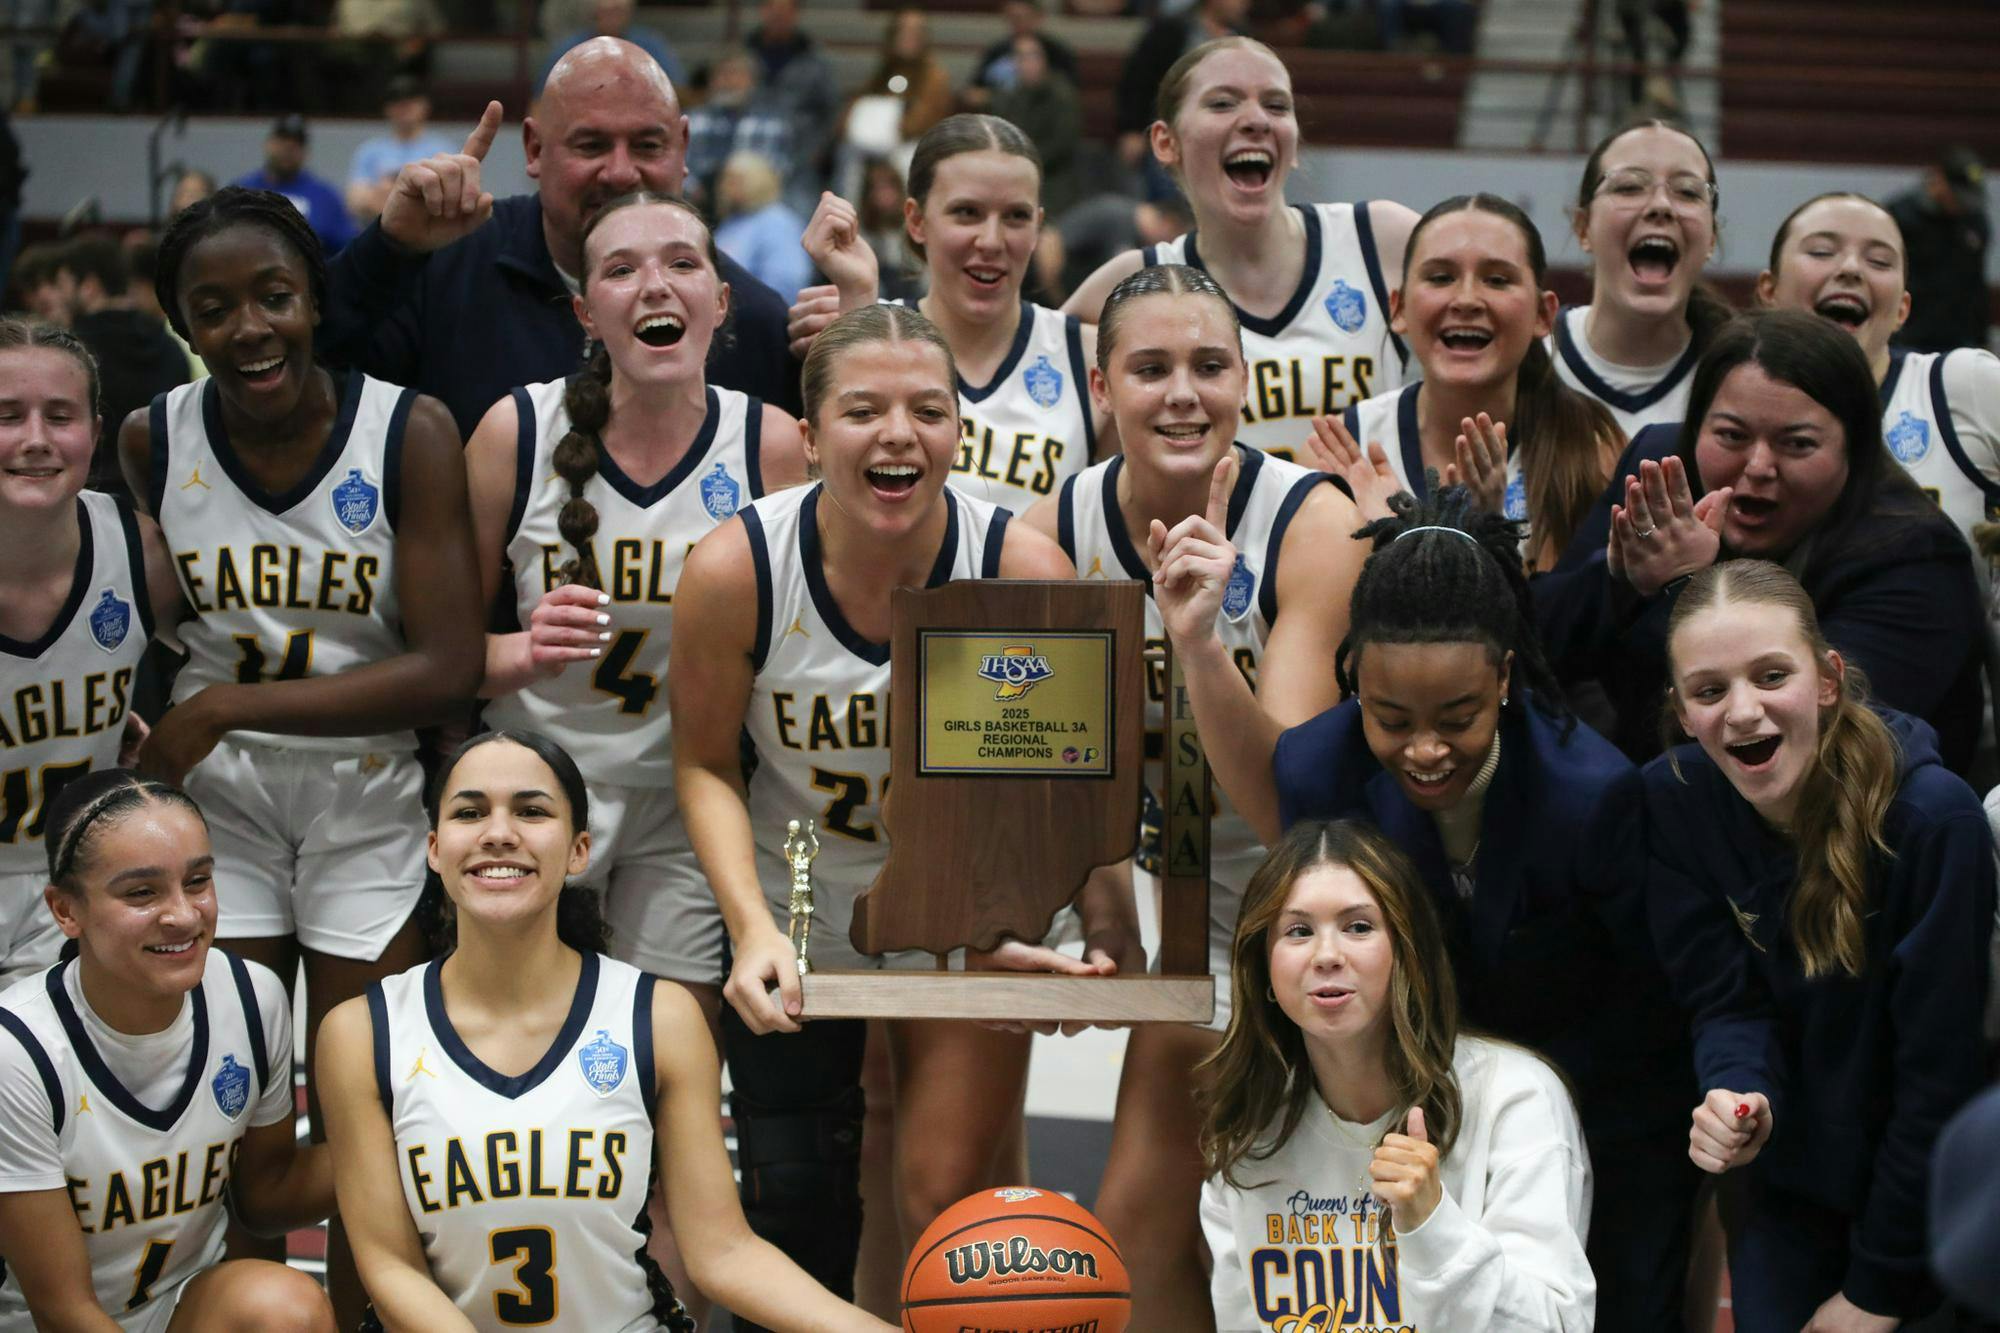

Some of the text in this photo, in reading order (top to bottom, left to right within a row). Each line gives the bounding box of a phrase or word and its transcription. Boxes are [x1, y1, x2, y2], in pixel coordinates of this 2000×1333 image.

[1241, 356, 1374, 424] GLES
[949, 416, 1064, 496] GLES
[176, 544, 379, 616] EAGLES
[591, 629, 657, 717] 4
[981, 654, 1052, 682] IHSAA
[944, 720, 1088, 733] GIRLS BASKETBALL 3A
[1001, 708, 1030, 720] 2025
[977, 746, 1053, 759] CHAMPIONS
[983, 734, 1048, 746] REGIONAL
[406, 1127, 628, 1216] EAGLES
[1267, 1213, 1339, 1244] BACK
[1286, 1190, 1349, 1220] Queens
[1353, 1191, 1373, 1223] of
[125, 1239, 176, 1312] 1
[487, 1224, 560, 1328] 3
[944, 1235, 1098, 1286] Wilson
